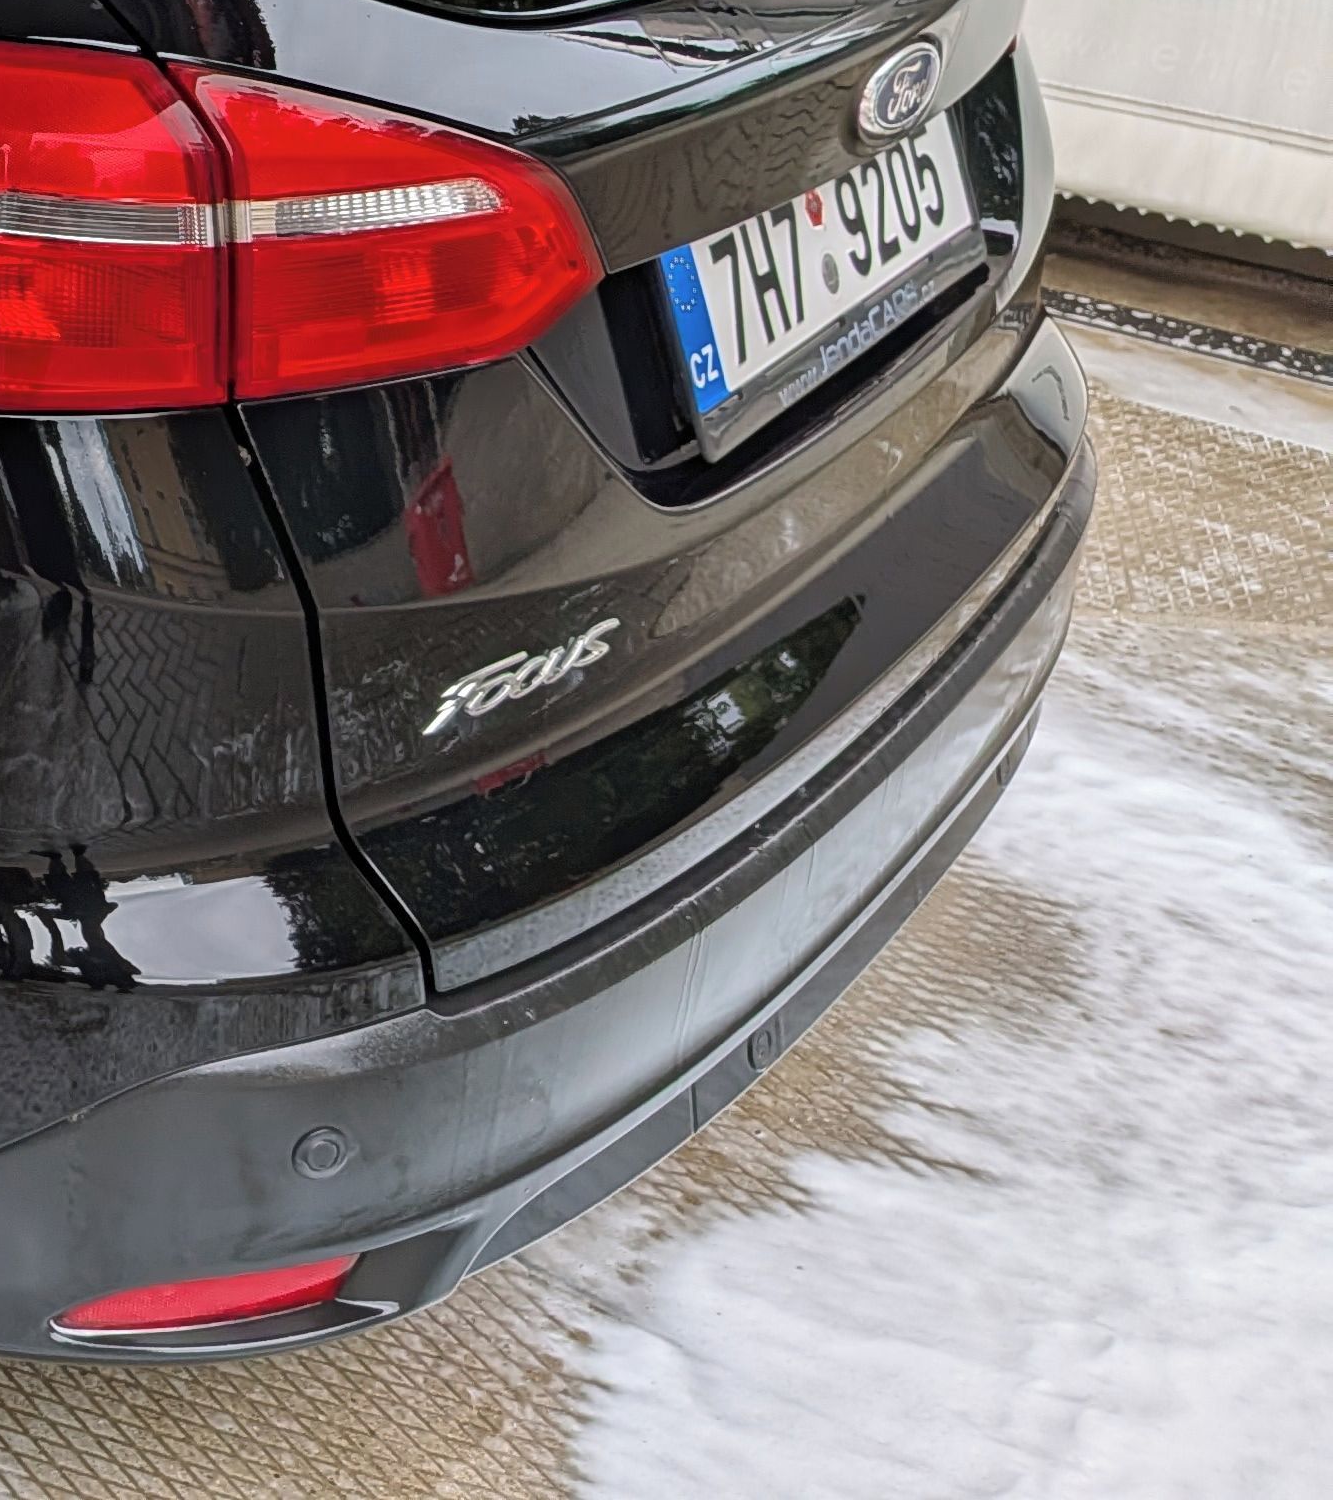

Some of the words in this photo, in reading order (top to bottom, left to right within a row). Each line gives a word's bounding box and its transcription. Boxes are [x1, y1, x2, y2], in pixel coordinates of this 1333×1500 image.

[887, 63, 931, 124] Ford
[709, 199, 805, 366] 7H7
[835, 124, 943, 277] 9205
[689, 342, 719, 389] CZ
[421, 615, 621, 736] Focus
